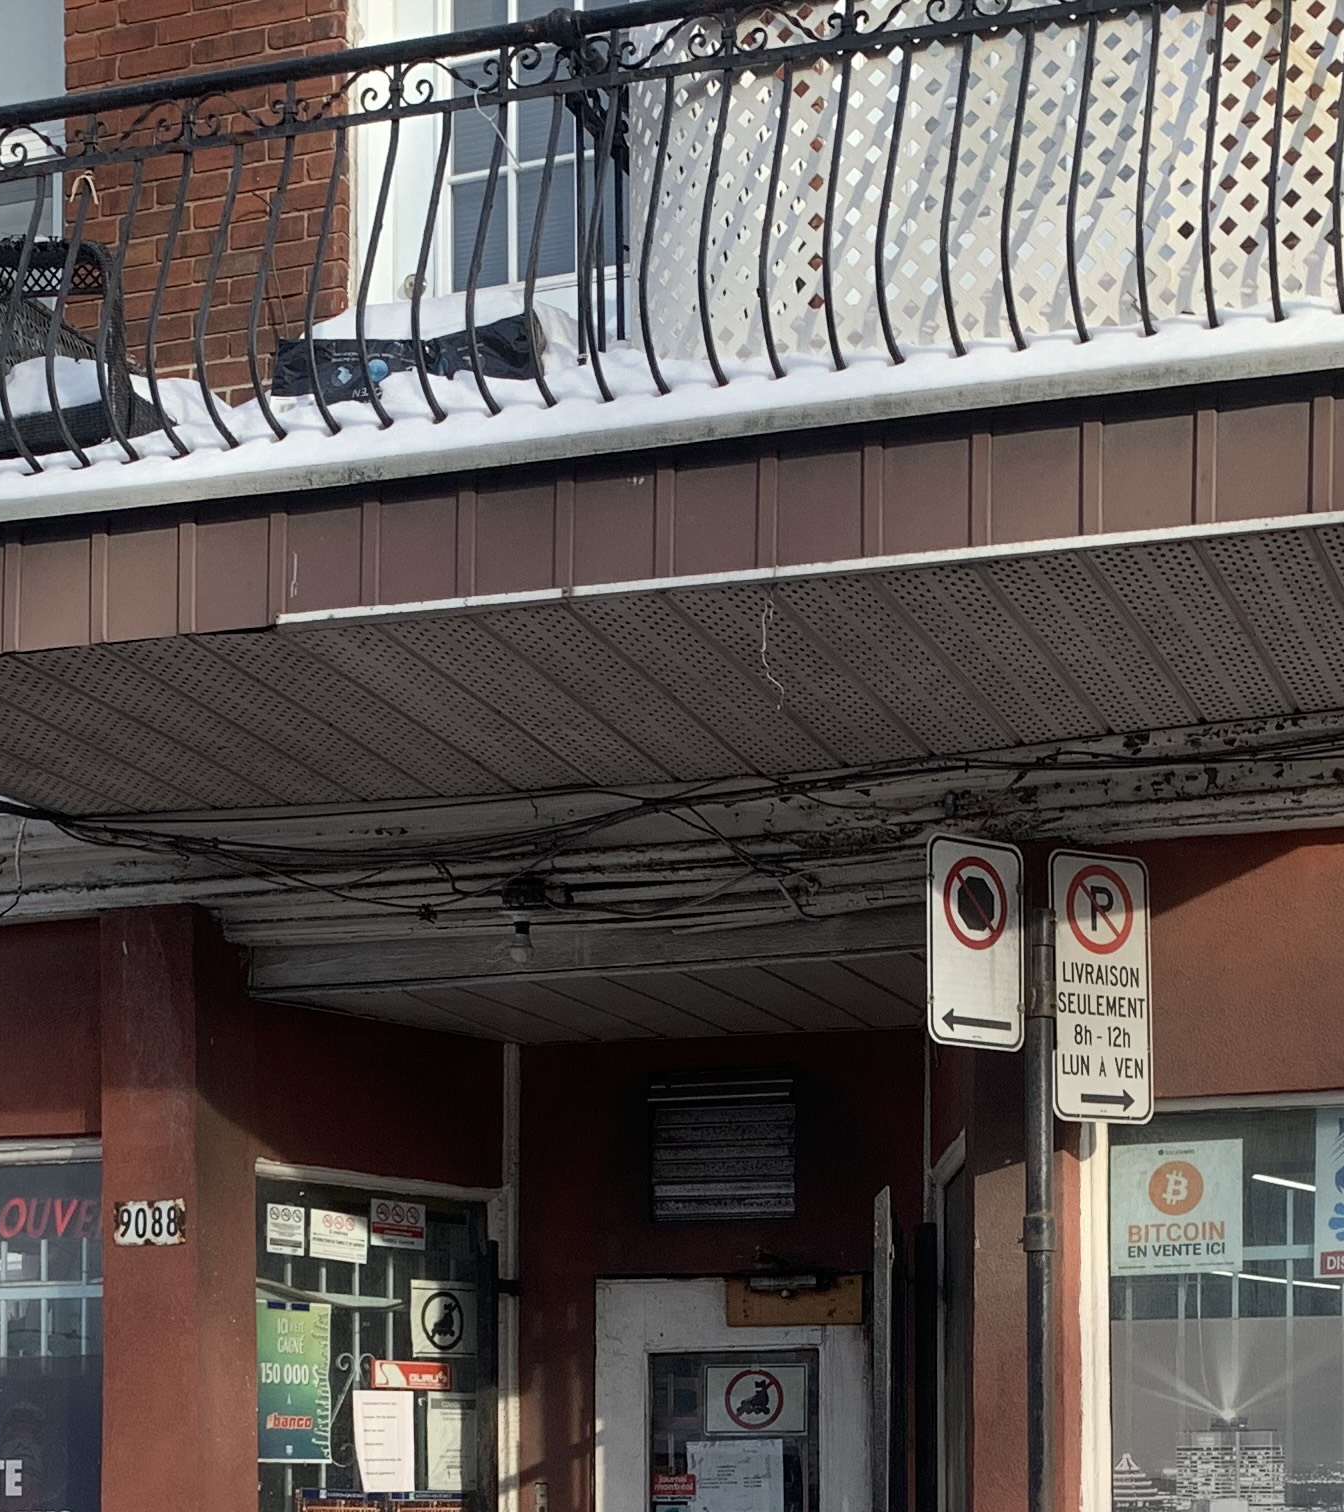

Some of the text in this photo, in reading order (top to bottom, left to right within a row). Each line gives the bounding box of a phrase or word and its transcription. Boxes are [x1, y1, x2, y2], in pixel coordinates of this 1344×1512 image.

[1062, 961, 1140, 988] LIVRAISON
[1058, 992, 1145, 1019] SEULEMENT
[1074, 1023, 1092, 1046] 8h
[1108, 1026, 1131, 1048] 12h
[1062, 1054, 1144, 1079] LUN À VEN
[119, 1206, 179, 1239] 9088
[1127, 1220, 1226, 1244] BITCOIN
[1127, 1241, 1226, 1259] EN VENTE ICI
[260, 1362, 281, 1384] 150
[283, 1363, 309, 1385] 000
[273, 1413, 312, 1428] banco
